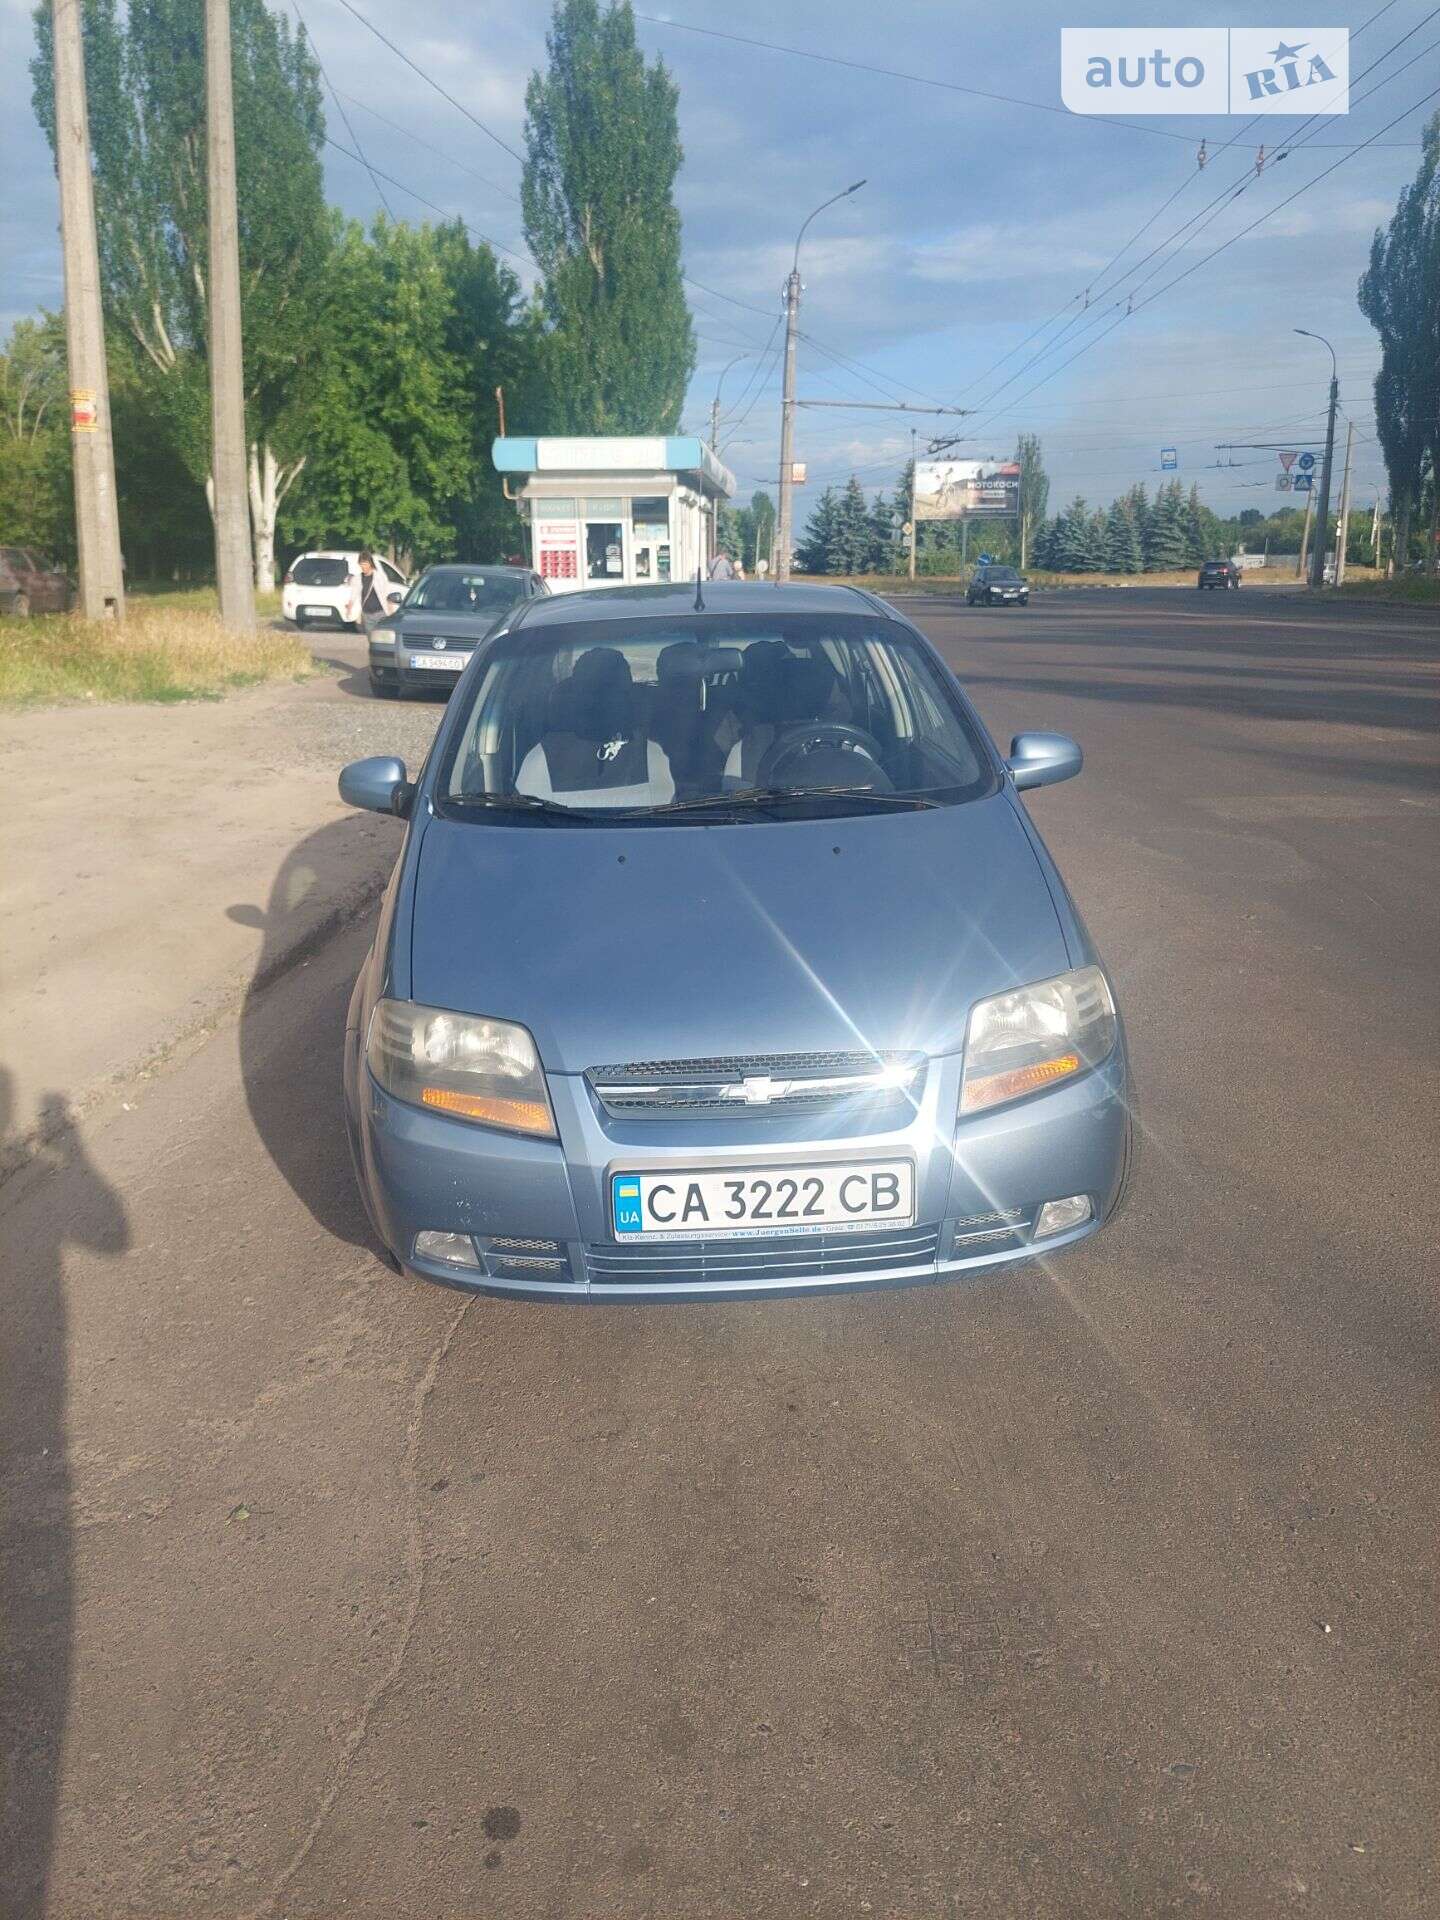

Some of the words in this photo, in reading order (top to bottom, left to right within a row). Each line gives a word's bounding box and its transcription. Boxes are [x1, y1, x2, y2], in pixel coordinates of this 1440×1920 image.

[647, 1183, 711, 1224] CA
[724, 1177, 825, 1220] 3222
[839, 1172, 900, 1213] CB
[620, 1212, 640, 1224] UA
